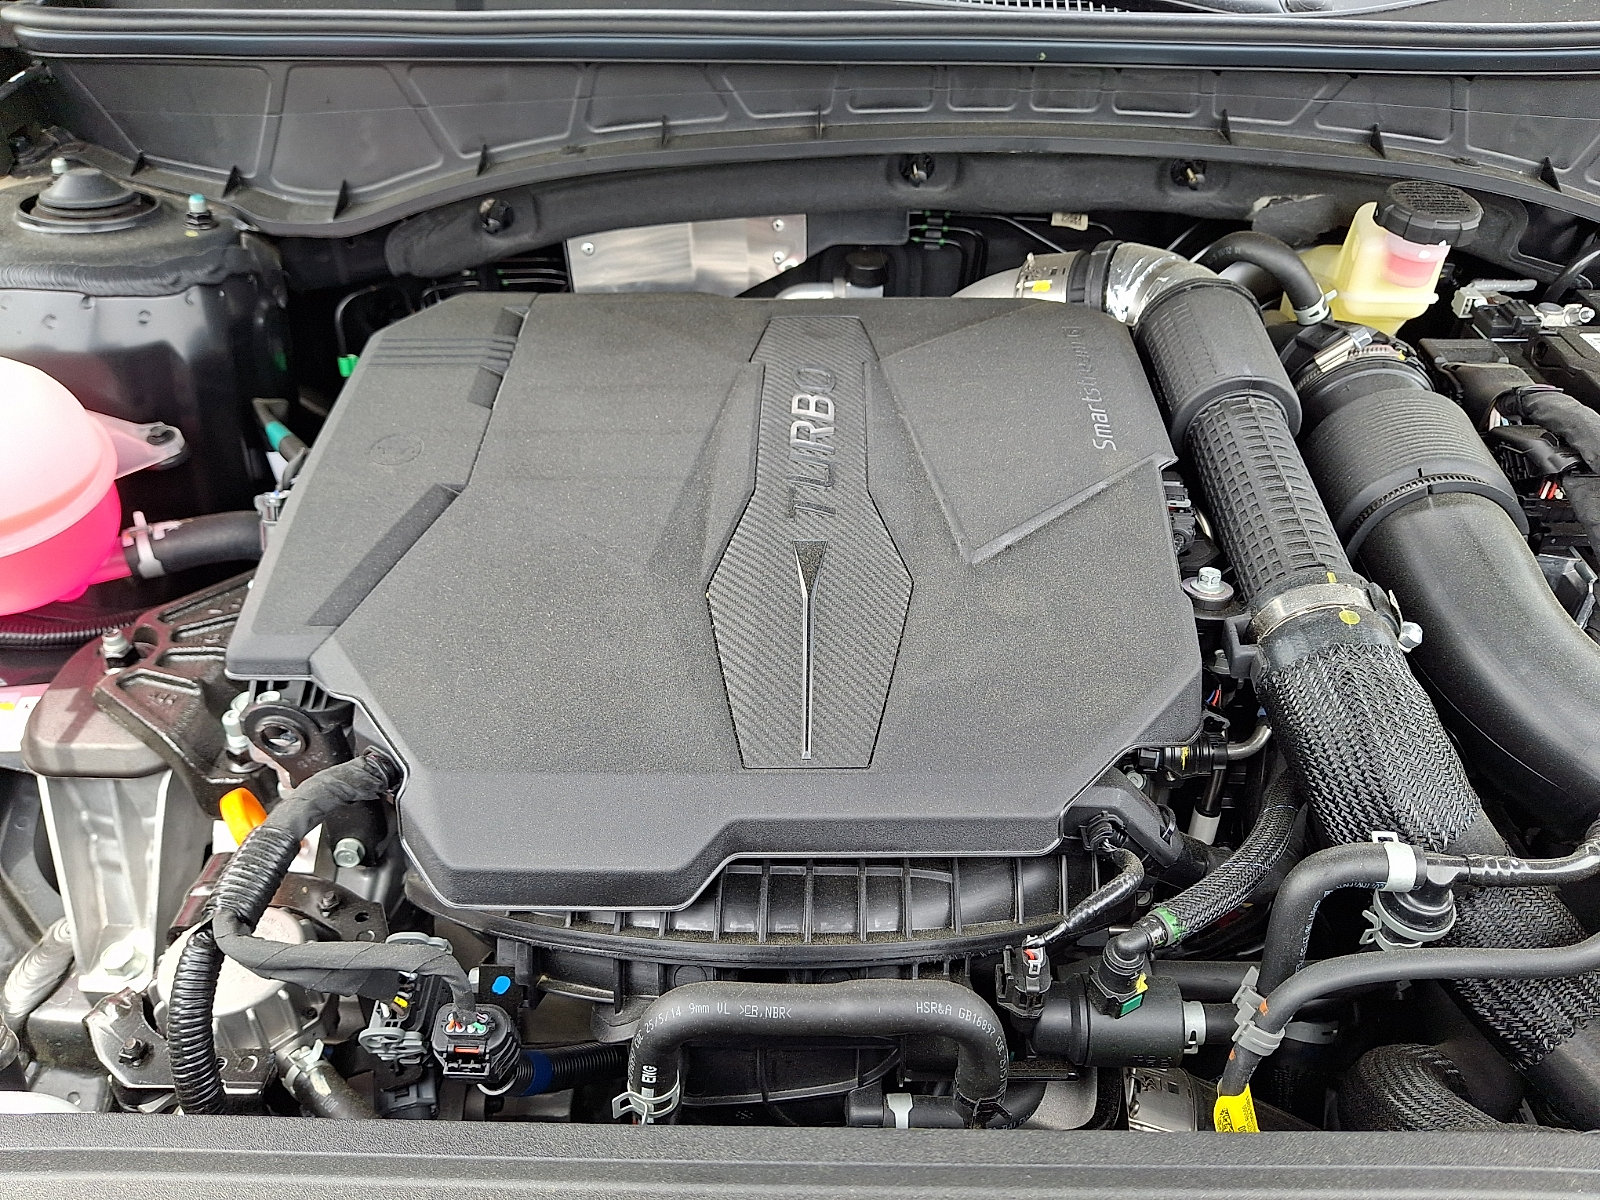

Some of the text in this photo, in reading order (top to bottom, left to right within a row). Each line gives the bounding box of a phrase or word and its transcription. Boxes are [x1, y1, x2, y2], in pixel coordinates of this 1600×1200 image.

[787, 363, 837, 520] TURBO
[644, 1005, 682, 1034] 25/5/14
[688, 1002, 710, 1014] 9mm
[916, 1001, 952, 1016] HSR&A
[641, 1065, 658, 1084] ENG
